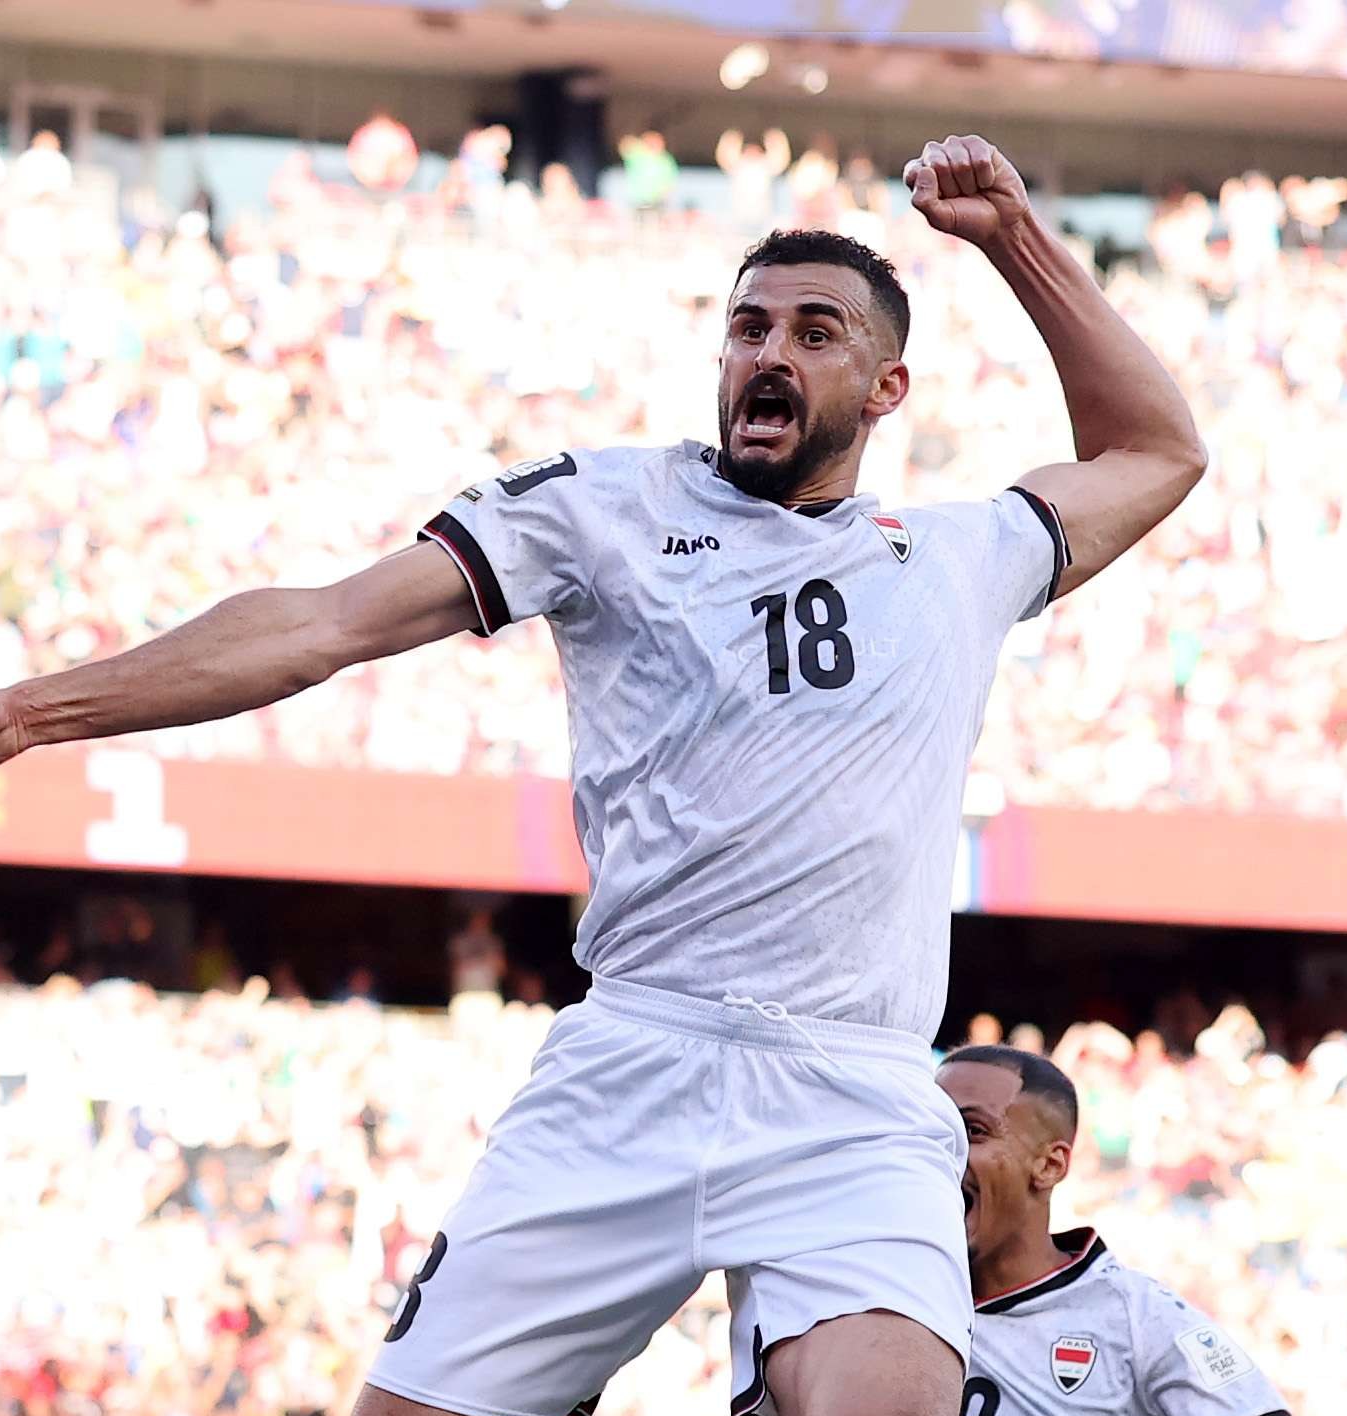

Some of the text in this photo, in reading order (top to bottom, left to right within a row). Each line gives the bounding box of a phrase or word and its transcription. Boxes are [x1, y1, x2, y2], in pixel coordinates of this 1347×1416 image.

[662, 535, 721, 556] JAKO
[750, 578, 855, 694] 18
[85, 749, 187, 866] 1
